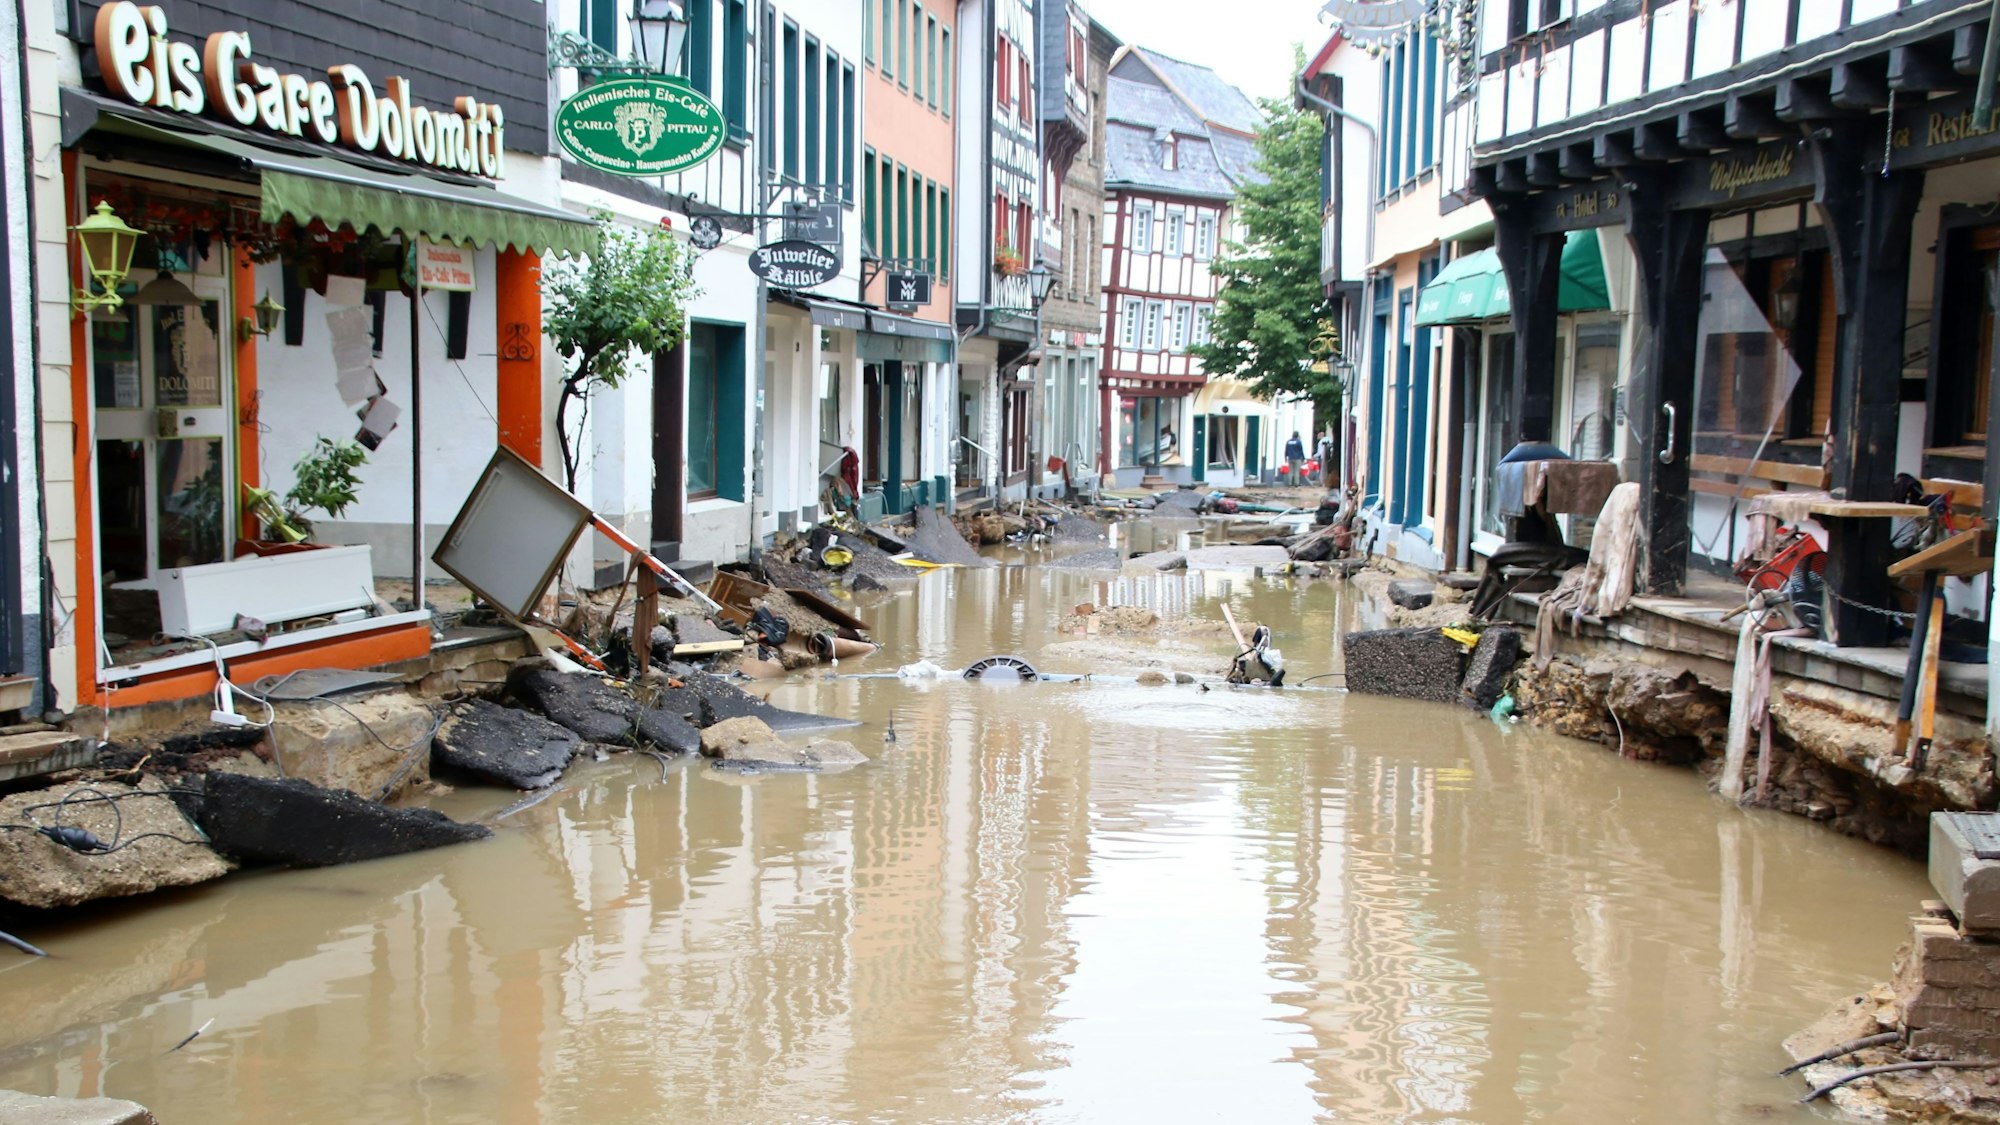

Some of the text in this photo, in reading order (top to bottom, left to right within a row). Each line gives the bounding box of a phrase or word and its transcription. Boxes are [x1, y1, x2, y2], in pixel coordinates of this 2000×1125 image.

[1335, 4, 1410, 27] HOTEL
[572, 85, 710, 119] Italienisches Eis-Café
[328, 63, 505, 181] Dolomiti
[573, 119, 708, 134] CARLO PITTAU
[636, 153, 693, 172] Hausgemachte
[690, 133, 718, 159] Kuchen
[1573, 190, 1598, 218] Hotel
[757, 247, 835, 270] Juwelier
[763, 264, 824, 287] Kälble
[159, 375, 217, 392] DOLOMITI
